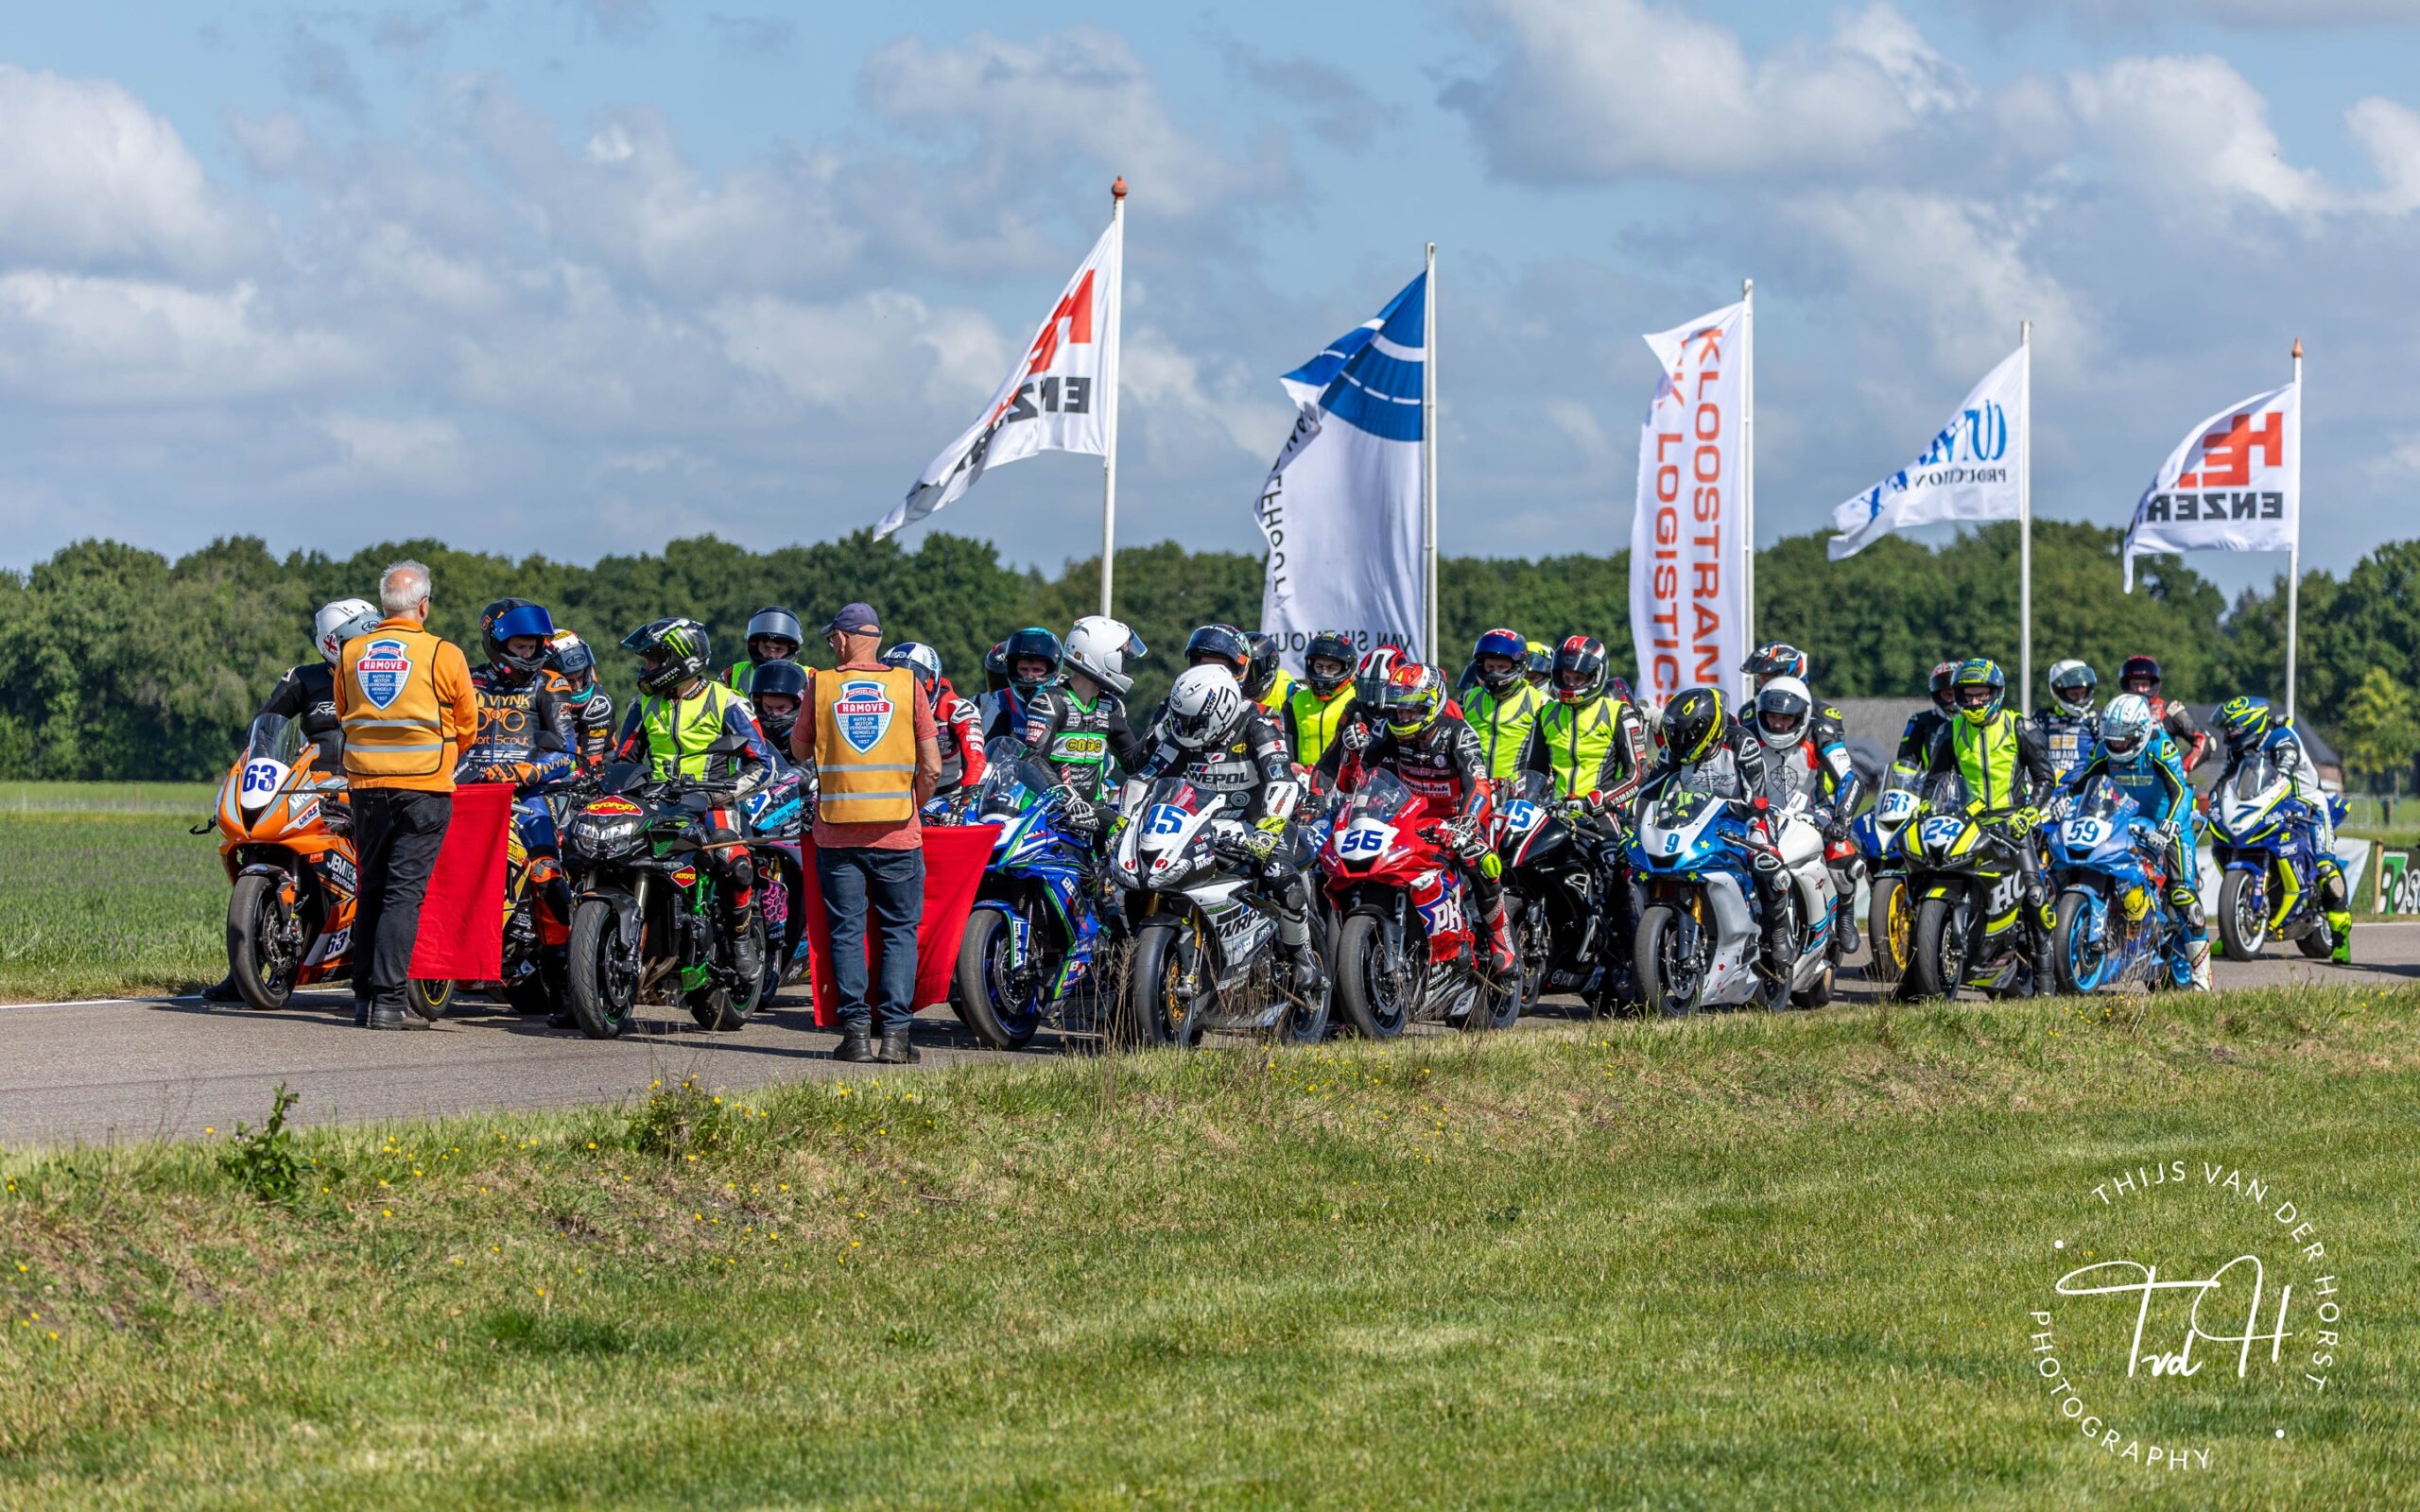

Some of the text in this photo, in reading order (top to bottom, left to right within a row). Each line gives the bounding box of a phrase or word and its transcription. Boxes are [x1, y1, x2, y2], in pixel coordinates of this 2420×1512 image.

[364, 662, 403, 670] HAMOVE
[489, 695, 531, 708] VYNK
[842, 703, 885, 713] HAMOVE
[494, 734, 529, 747] Scout
[242, 764, 278, 793] 63
[1610, 784, 1639, 806] YAMAHA
[1142, 803, 1188, 836] 45
[2231, 804, 2263, 824] 7
[1923, 818, 1961, 841] 24
[2066, 819, 2100, 844] 59
[1340, 829, 1385, 853] 56
[1665, 833, 1681, 853] 9
[1194, 855, 1215, 870] WRP
[331, 872, 355, 892] SOLUTIONS
[1216, 908, 1258, 938] WRP
[325, 931, 348, 954] 63
